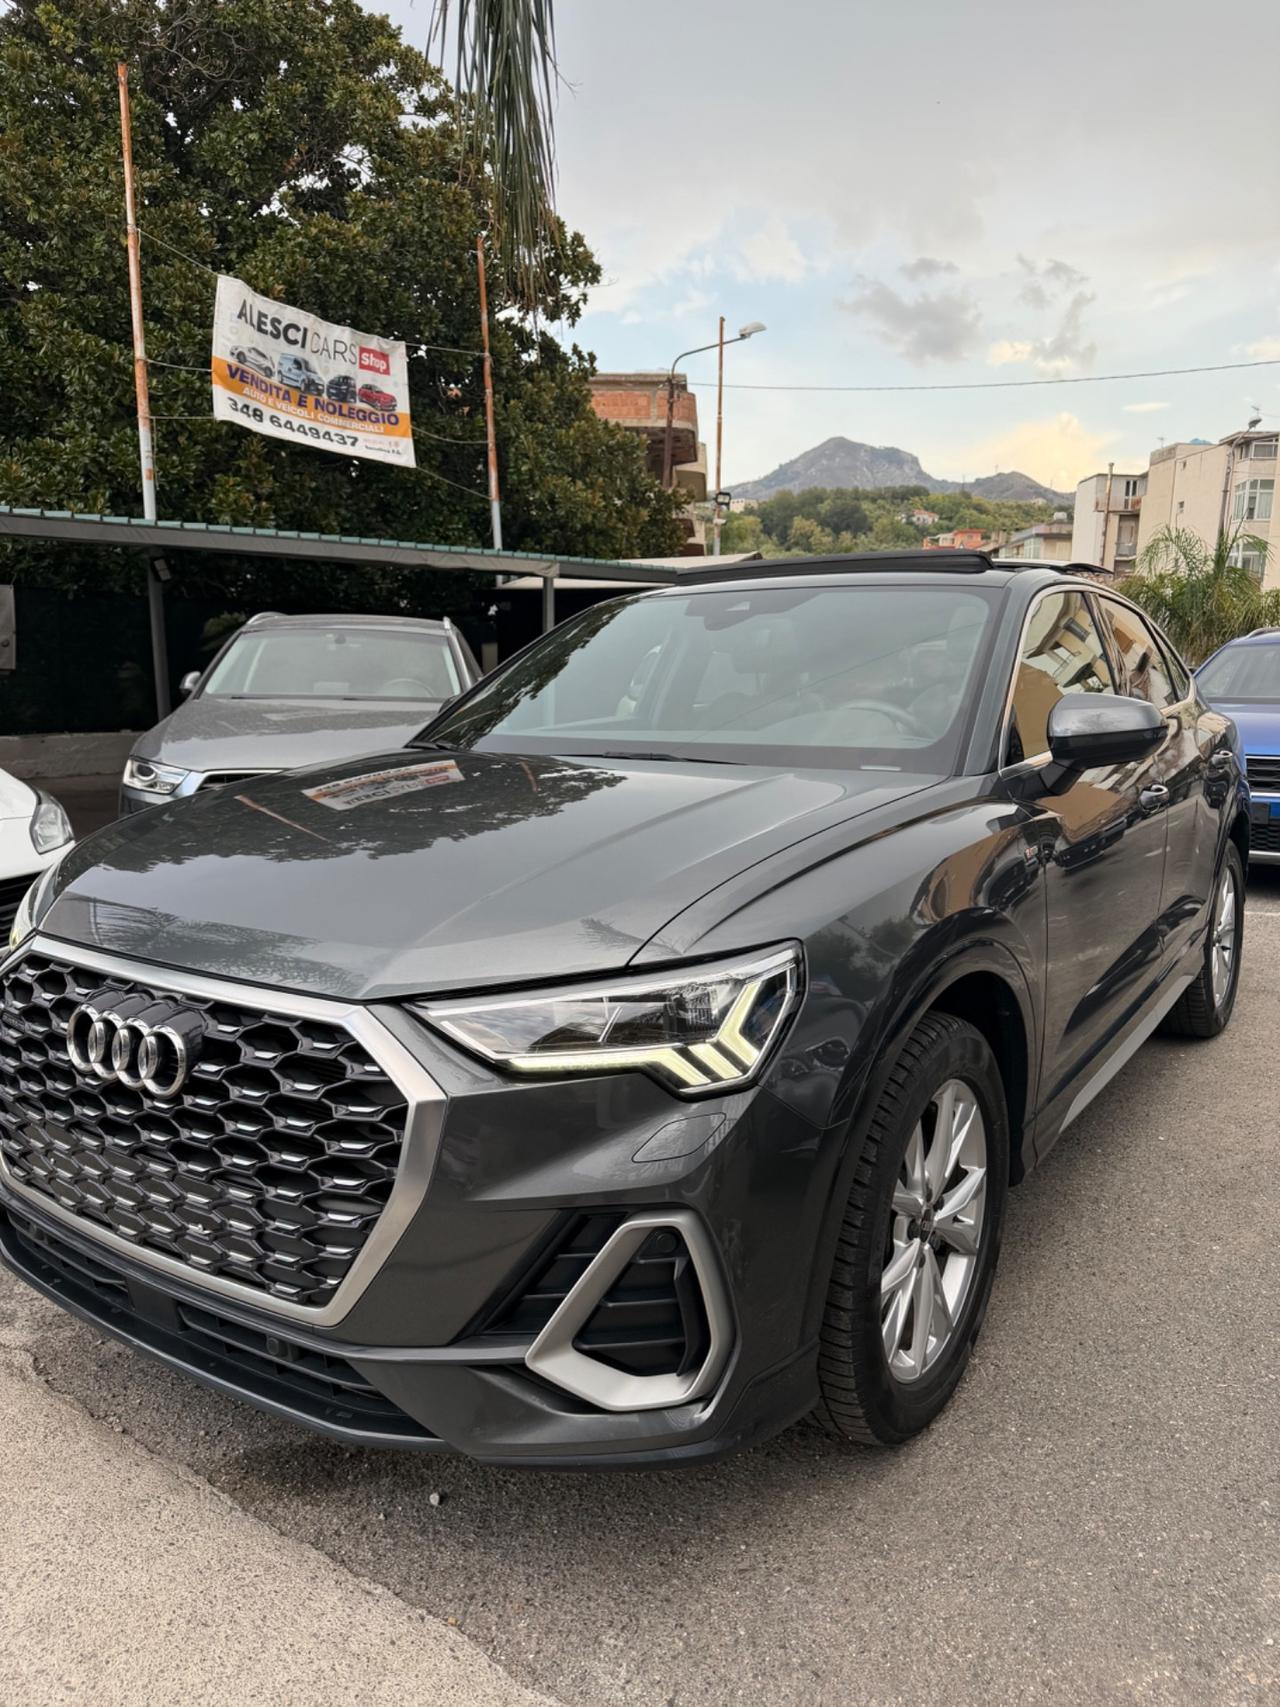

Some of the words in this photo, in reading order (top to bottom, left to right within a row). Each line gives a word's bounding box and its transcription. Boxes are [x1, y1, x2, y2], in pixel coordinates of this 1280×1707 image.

[237, 299, 308, 349] ALESCI
[310, 332, 358, 365] CARS
[361, 353, 386, 371] Shop
[226, 364, 292, 401] VENDITA
[298, 395, 307, 408] E
[314, 399, 399, 426] NOLEGGIO
[227, 396, 264, 423] 348
[269, 414, 359, 447] 6449437
[276, 401, 315, 420] VEICOLI
[317, 413, 384, 433] COMMERCIALI
